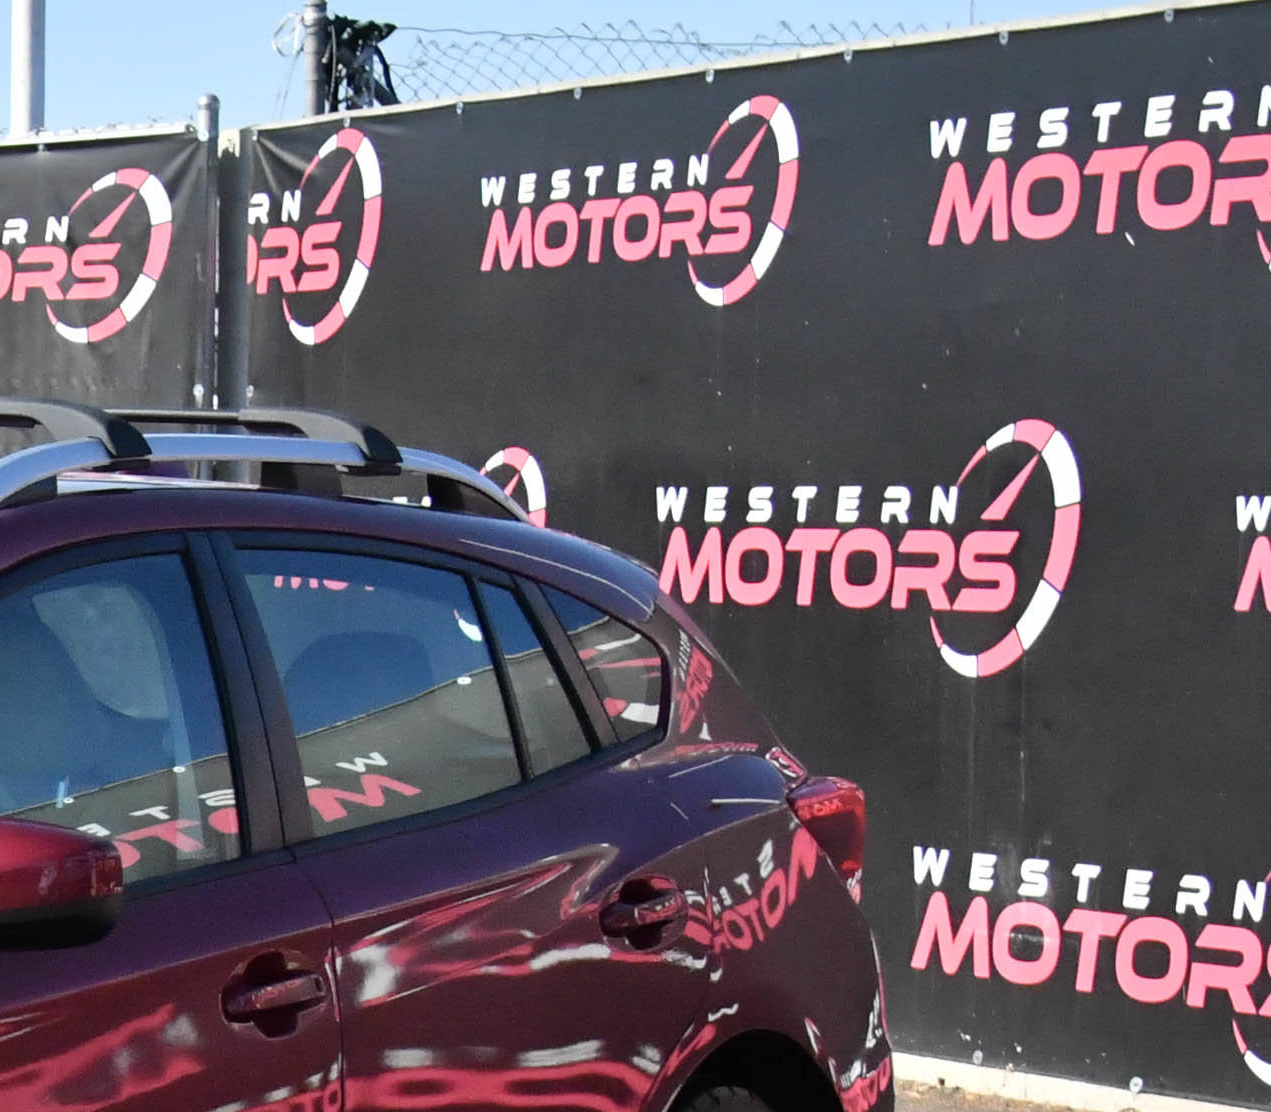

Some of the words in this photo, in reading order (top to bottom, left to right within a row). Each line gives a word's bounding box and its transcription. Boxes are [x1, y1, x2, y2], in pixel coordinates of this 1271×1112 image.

[481, 153, 709, 207] WESTERN
[928, 134, 1271, 246] MOTOR
[480, 185, 755, 272] MOTORS
[656, 485, 959, 525] WESTERN
[659, 526, 1020, 612] MOTORS
[913, 846, 1267, 922] WESTERN
[910, 890, 1271, 1017] MOTOR
